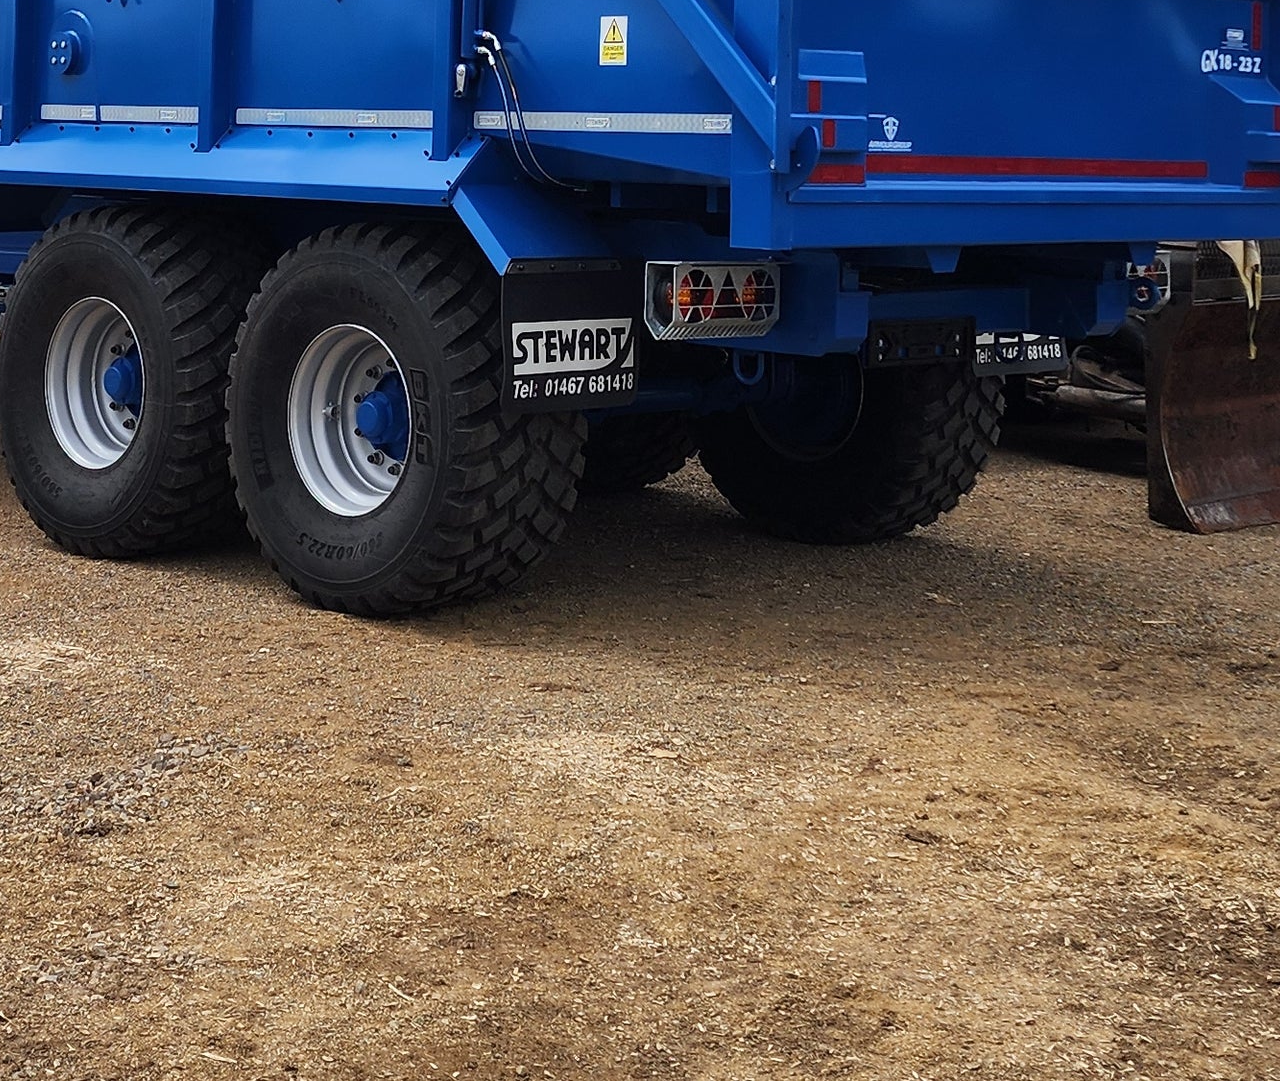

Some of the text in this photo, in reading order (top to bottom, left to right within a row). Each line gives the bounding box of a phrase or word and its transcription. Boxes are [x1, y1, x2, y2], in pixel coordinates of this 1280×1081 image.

[513, 326, 633, 372] STEWART
[975, 348, 992, 364] Tel:
[1027, 343, 1062, 360] 681418
[513, 373, 634, 399] Tel: 01467 681418
[409, 367, 433, 464] BKT
